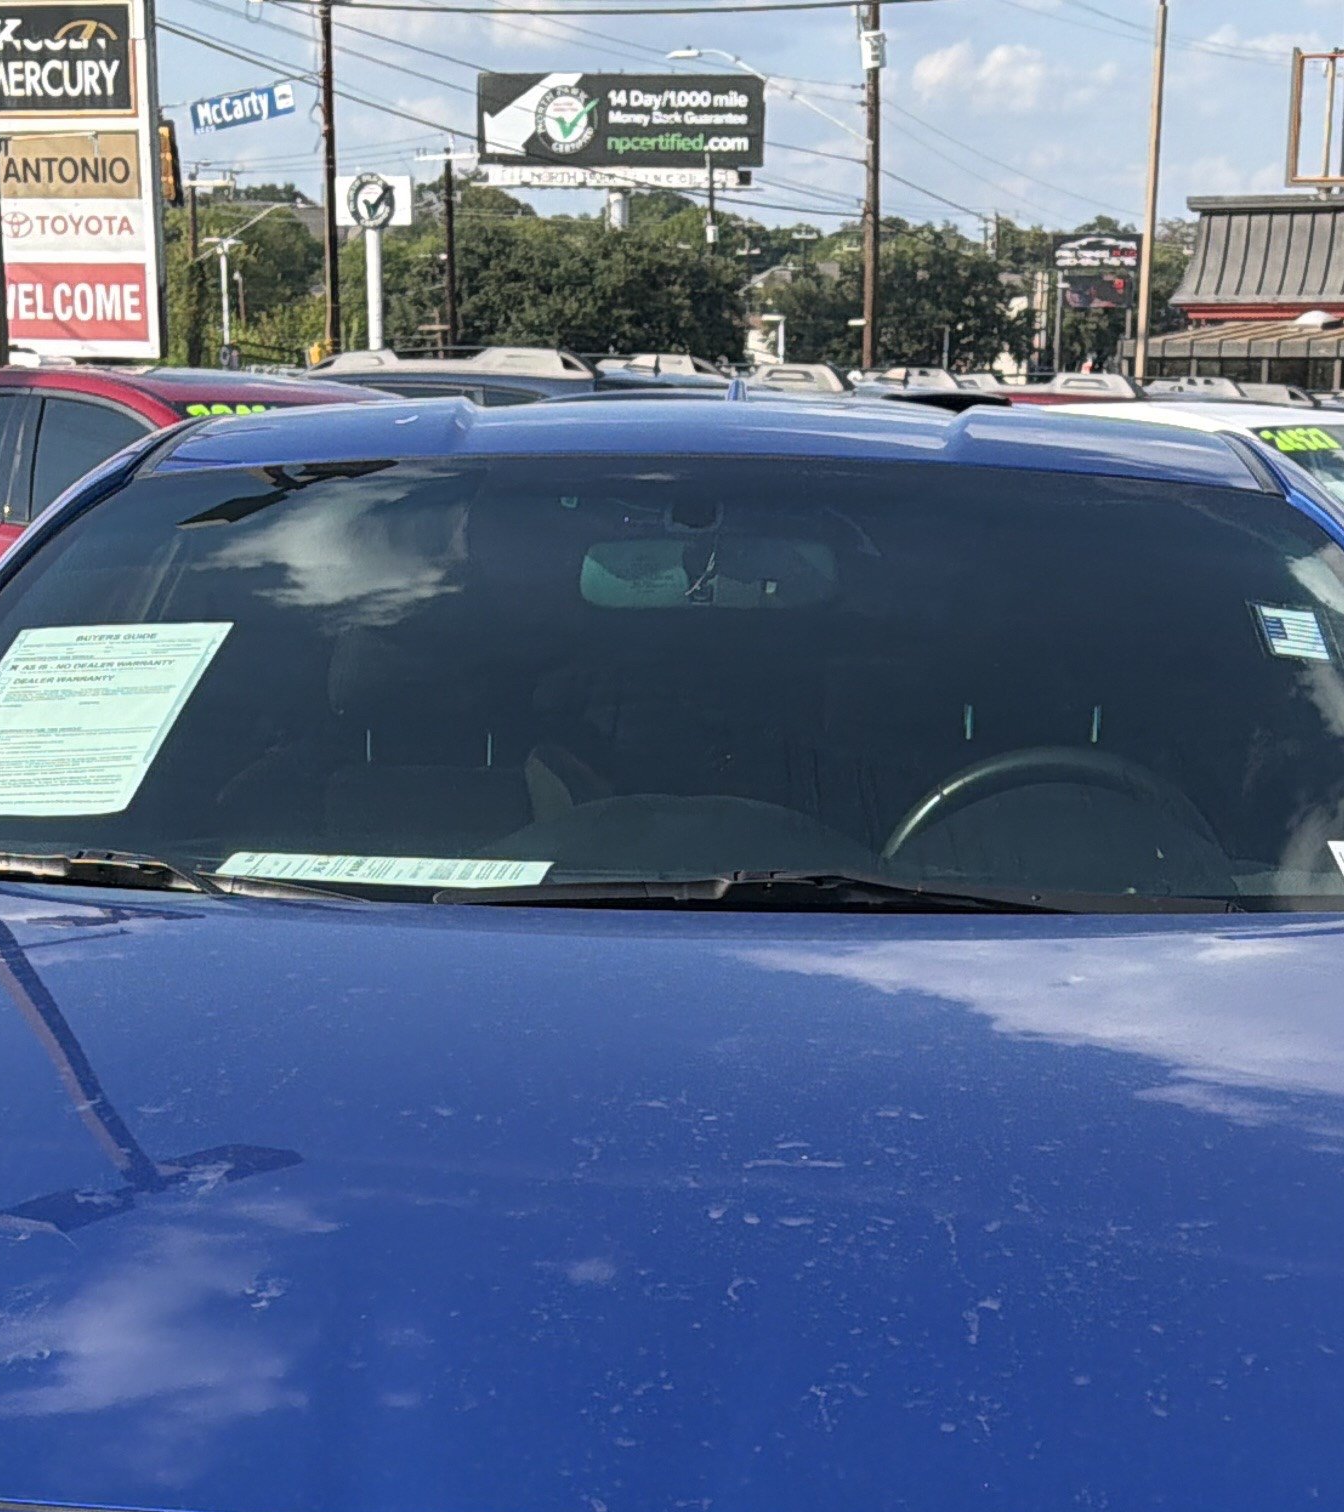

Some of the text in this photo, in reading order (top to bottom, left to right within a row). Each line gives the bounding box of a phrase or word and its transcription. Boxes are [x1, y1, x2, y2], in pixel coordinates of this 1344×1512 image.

[607, 89, 627, 107] 14
[713, 90, 748, 107] mile
[197, 91, 269, 126] McCarty
[608, 110, 650, 127] Money
[683, 111, 748, 124] Guarantee
[607, 132, 749, 154] npcertified.com
[3, 156, 131, 184] ANTONIO
[35, 215, 135, 236] TOYOTA
[123, 632, 159, 641] GUIDE
[117, 659, 176, 667] WARRANTY
[57, 674, 115, 683] WARRANTY
